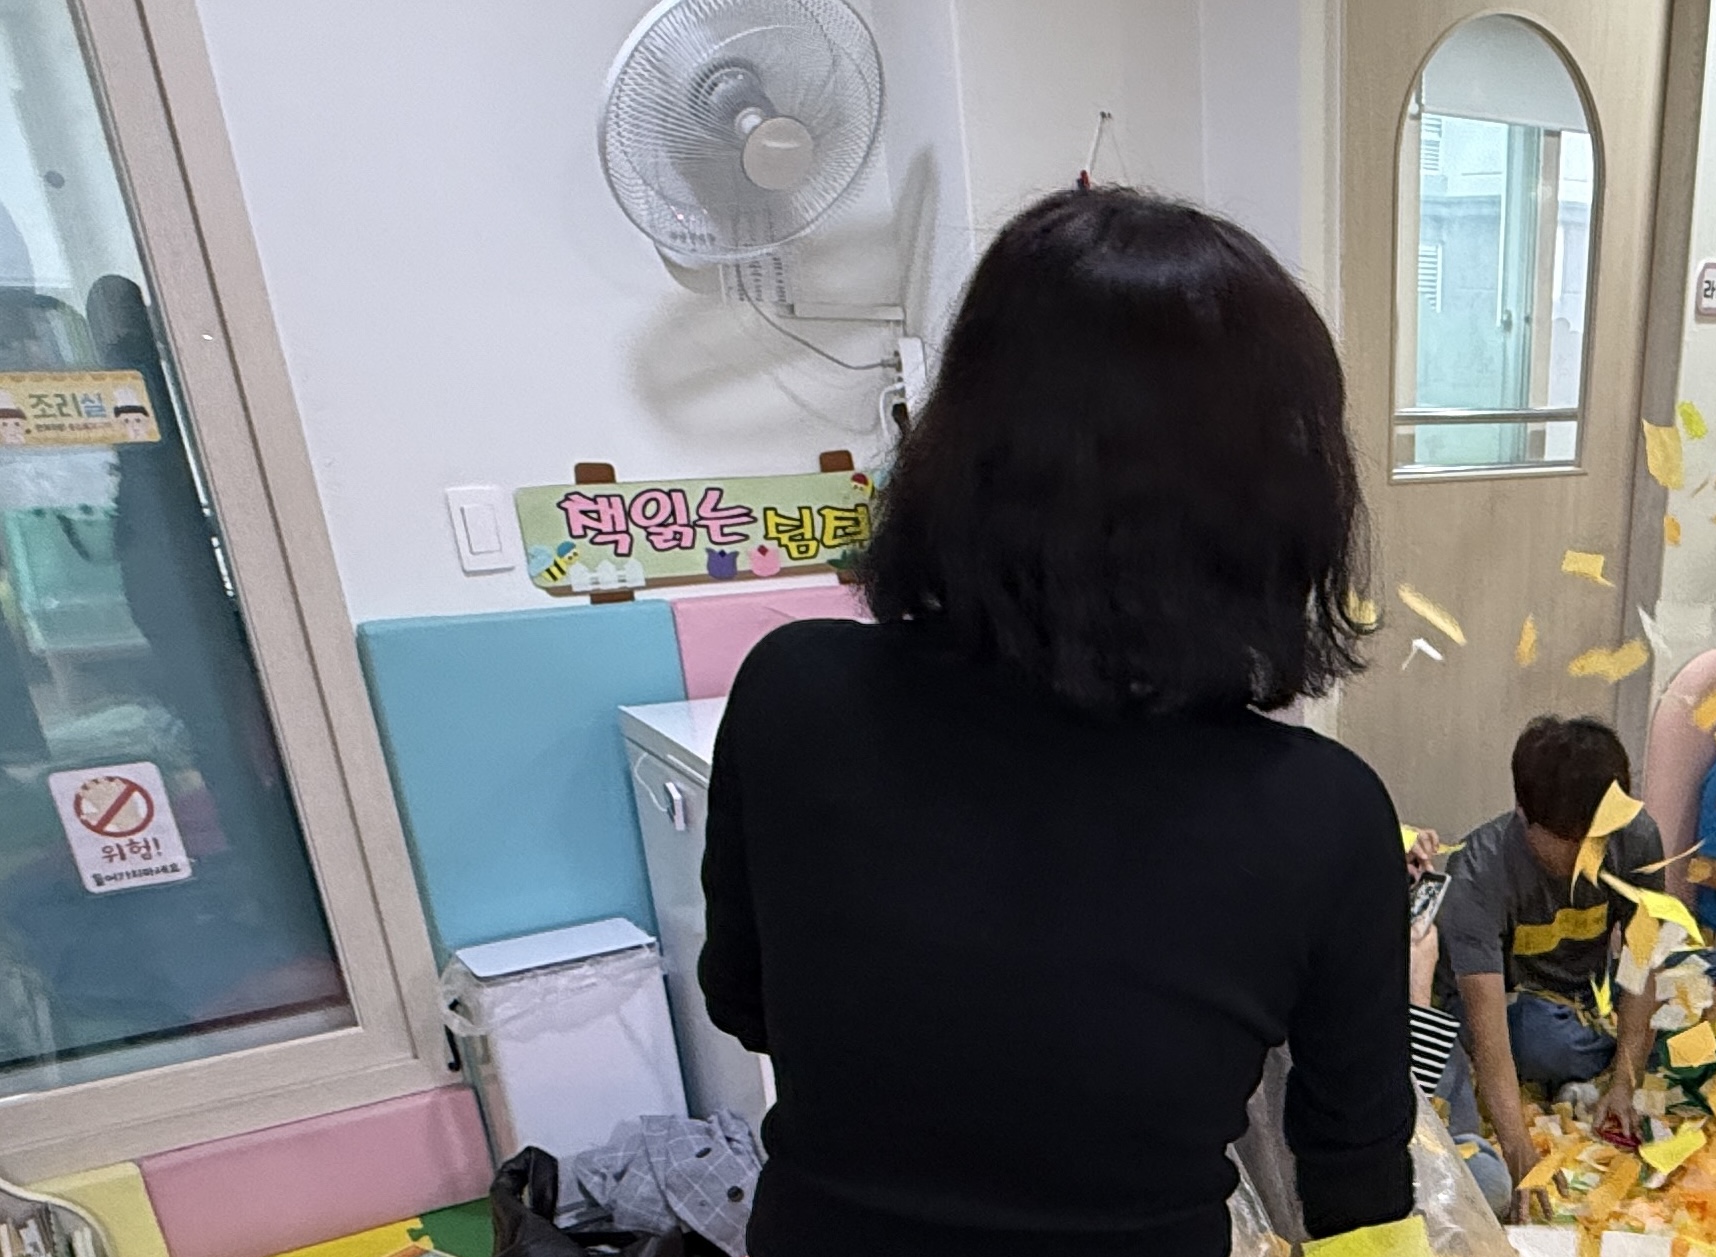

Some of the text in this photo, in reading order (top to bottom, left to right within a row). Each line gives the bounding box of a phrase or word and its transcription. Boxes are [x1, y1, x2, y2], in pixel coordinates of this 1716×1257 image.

[28, 393, 107, 418] 조리실
[557, 487, 757, 557] 책읽는
[102, 837, 163, 863] 위험!
